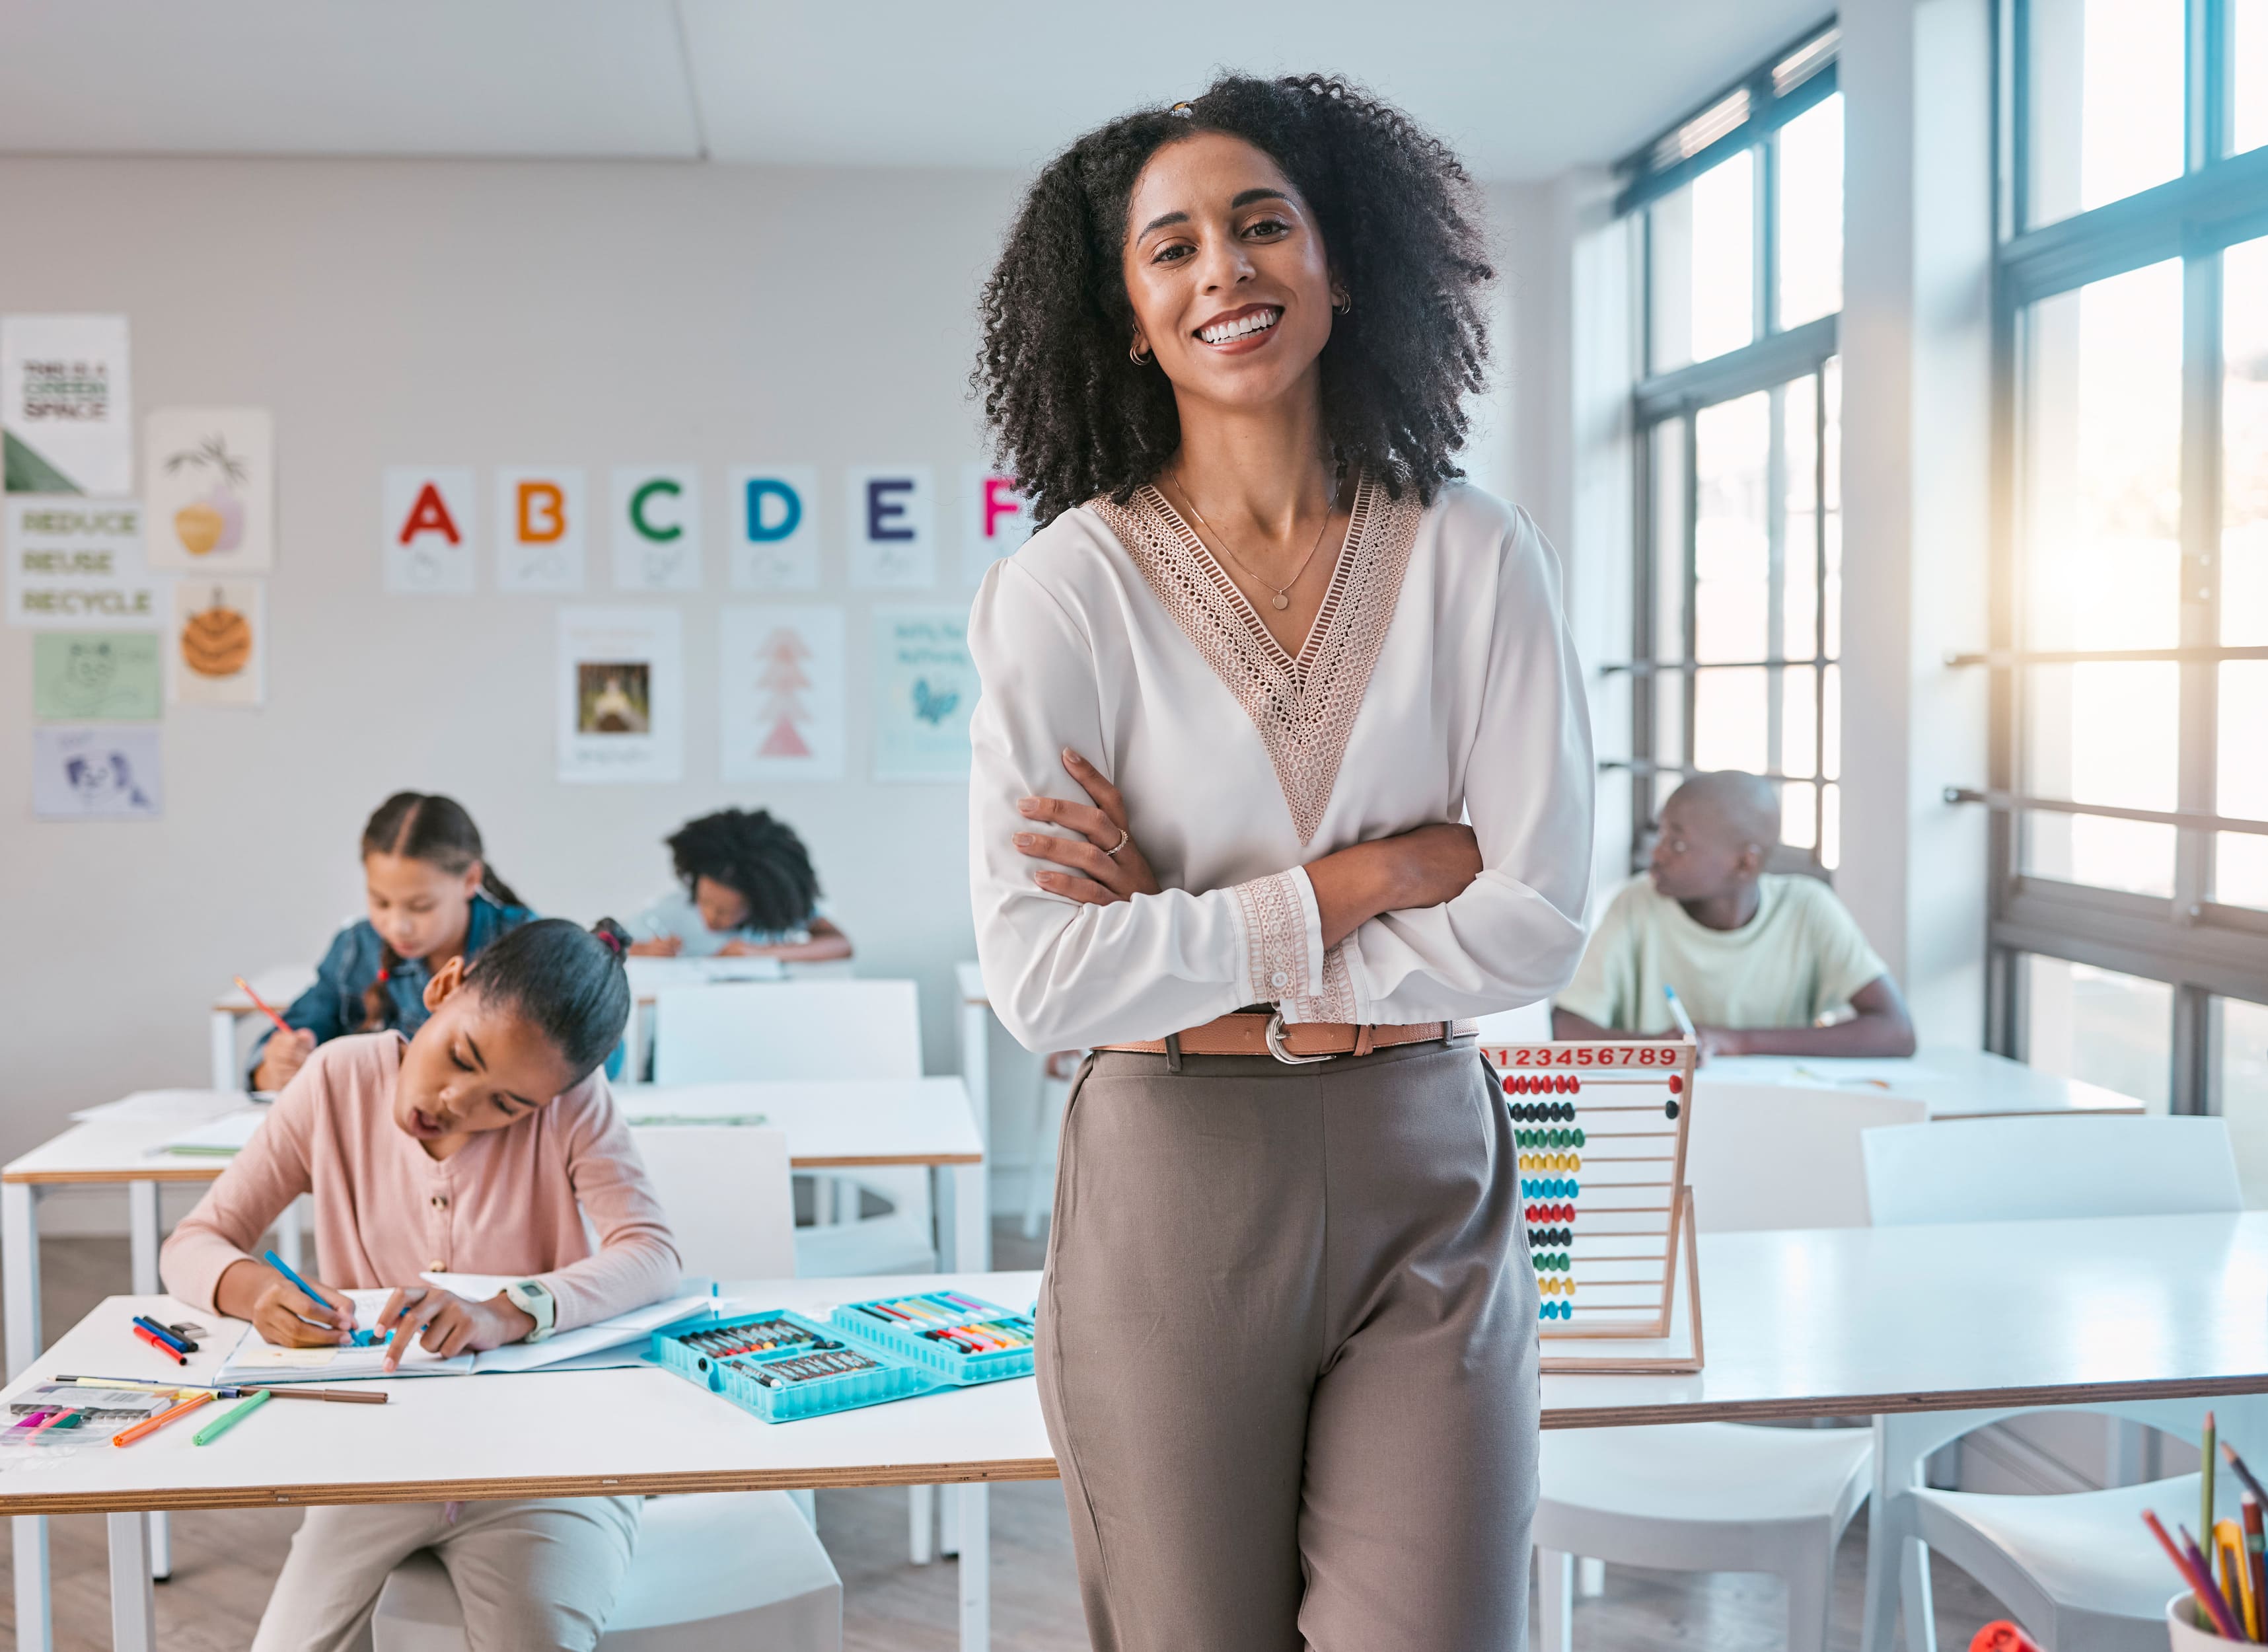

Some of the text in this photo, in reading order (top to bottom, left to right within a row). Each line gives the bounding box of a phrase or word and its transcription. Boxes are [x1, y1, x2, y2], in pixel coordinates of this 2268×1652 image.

[24, 400, 107, 420] SPACE
[22, 511, 138, 535] REDUCE
[398, 477, 1021, 546] A B C D E F
[22, 550, 113, 574] REUSE
[22, 589, 152, 614] RECYCLE
